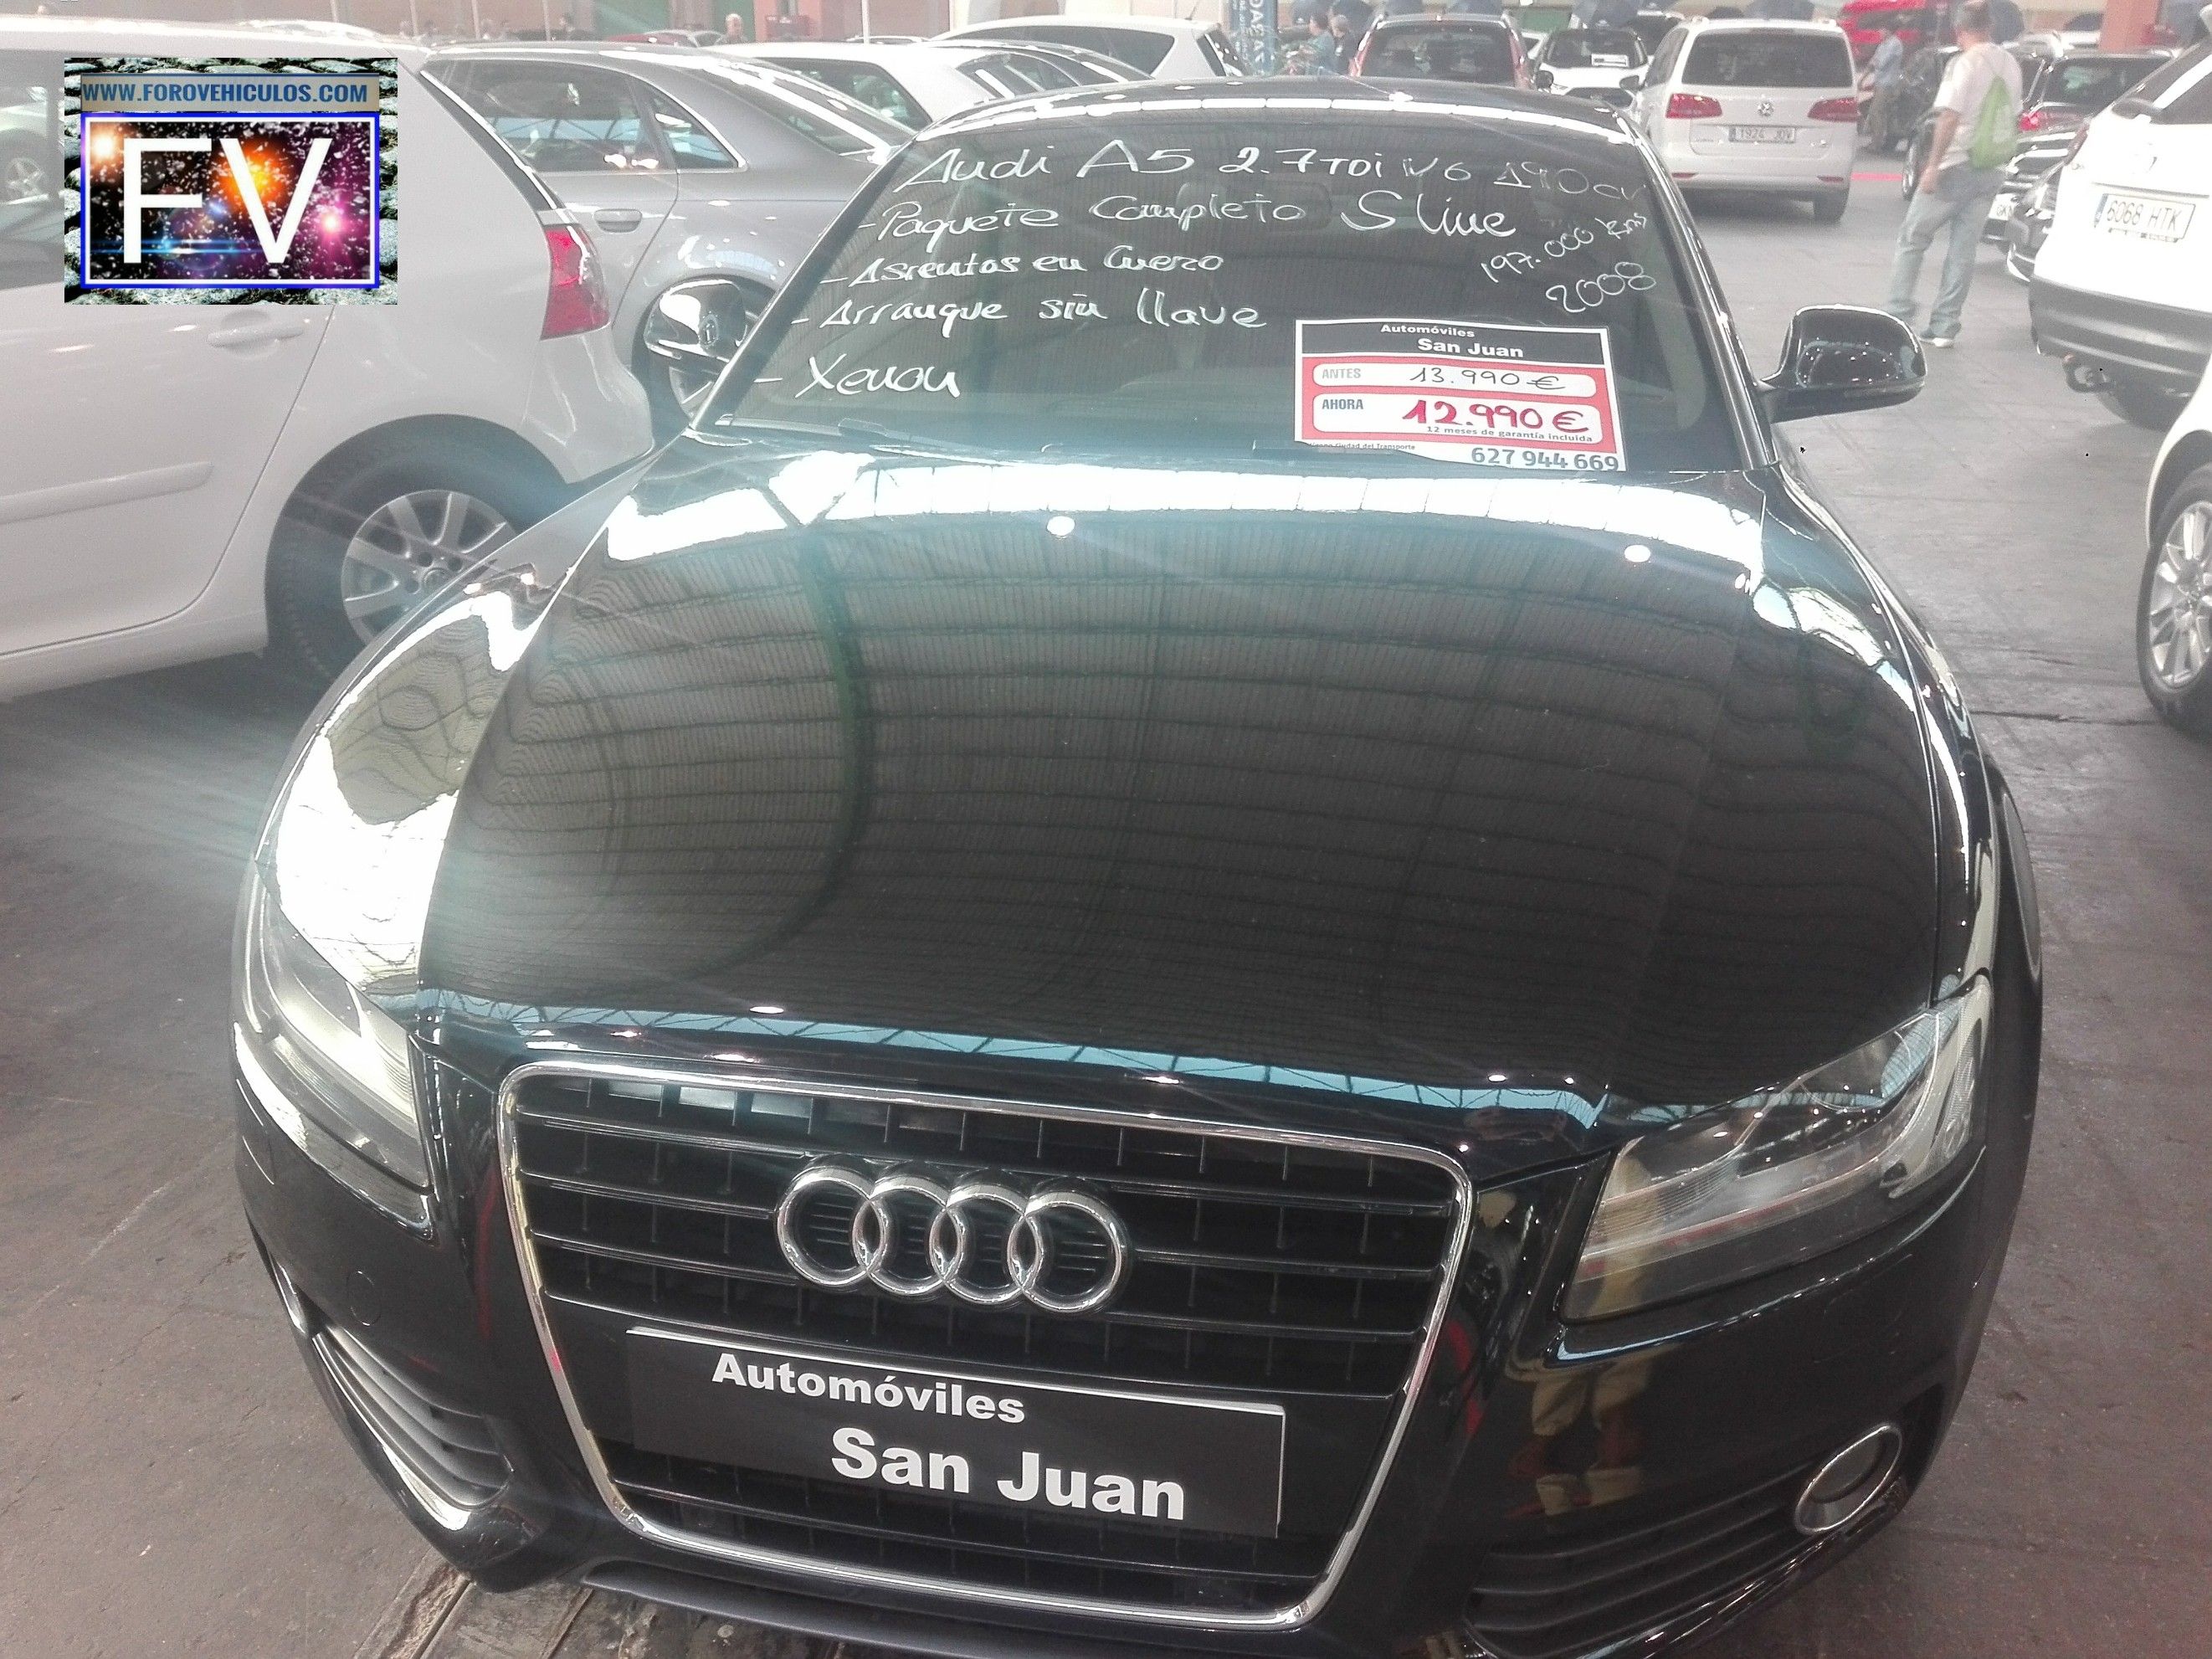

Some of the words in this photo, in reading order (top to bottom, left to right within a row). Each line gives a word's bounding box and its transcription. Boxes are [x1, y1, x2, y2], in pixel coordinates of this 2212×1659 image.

[892, 145, 1054, 193] Audi
[1075, 139, 1195, 178] A5
[1088, 192, 1306, 232] Completo
[1103, 244, 1224, 272] Cuero
[1545, 261, 1657, 314] 2008
[1137, 286, 1267, 328] llave
[1380, 324, 1476, 338] Automóviles
[1417, 337, 1461, 354] San
[1467, 340, 1524, 359] Juan
[1321, 367, 1362, 380] ANTES
[1321, 398, 1364, 411] AHORA
[1427, 425, 1440, 434] 12
[1481, 429, 1495, 437] de
[1498, 430, 1546, 440] garantía
[1548, 433, 1594, 443] incluida
[1470, 446, 1516, 465] 627
[1522, 449, 1568, 470] 944
[1573, 454, 1619, 472] 669
[710, 1351, 1027, 1425] Automóviles
[830, 1426, 971, 1495] San
[996, 1449, 1185, 1522] Juan
